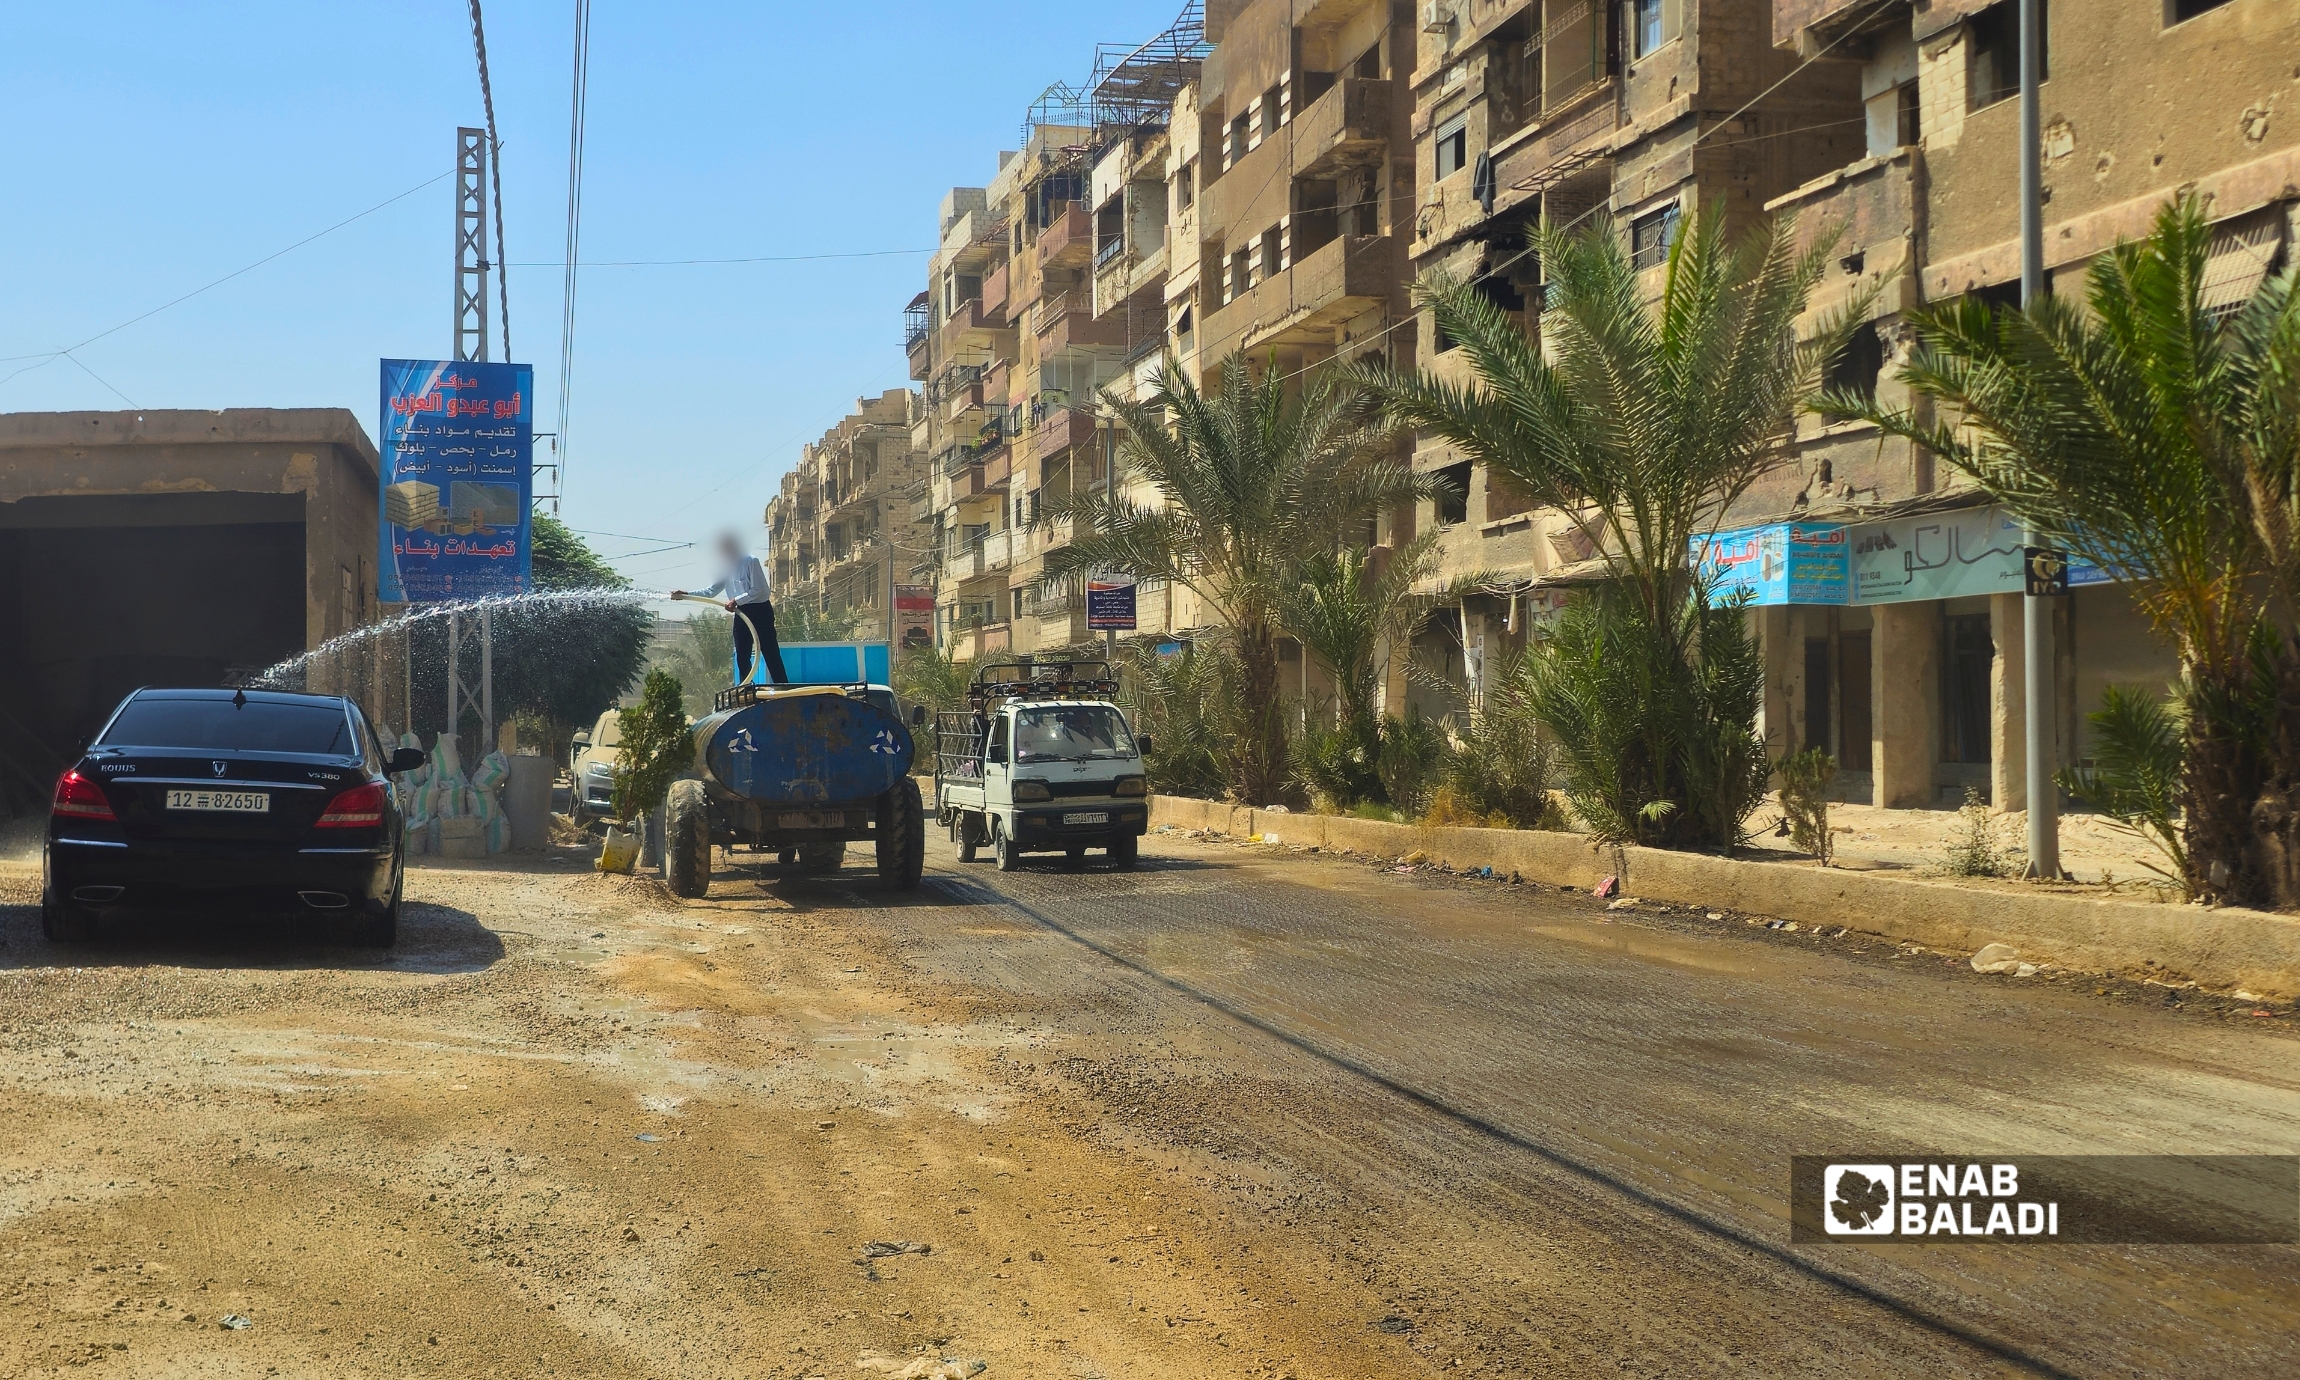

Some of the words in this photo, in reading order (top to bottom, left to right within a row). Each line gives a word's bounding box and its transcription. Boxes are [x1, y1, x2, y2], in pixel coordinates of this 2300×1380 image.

[433, 374, 478, 390] مركز
[390, 392, 443, 417] العزب
[446, 397, 490, 418] عبدو
[493, 391, 522, 420] أبو
[395, 423, 430, 437] بناء
[435, 425, 470, 438] مواد
[474, 427, 517, 439] تقديم
[394, 439, 426, 455] بلوك
[439, 446, 476, 456] بحص
[489, 445, 517, 458] رمل
[480, 465, 516, 476] إسمنت
[394, 537, 440, 559] بناء
[444, 538, 517, 559] تعهدات
[172, 792, 192, 808] 12
[213, 794, 263, 810] 82650
